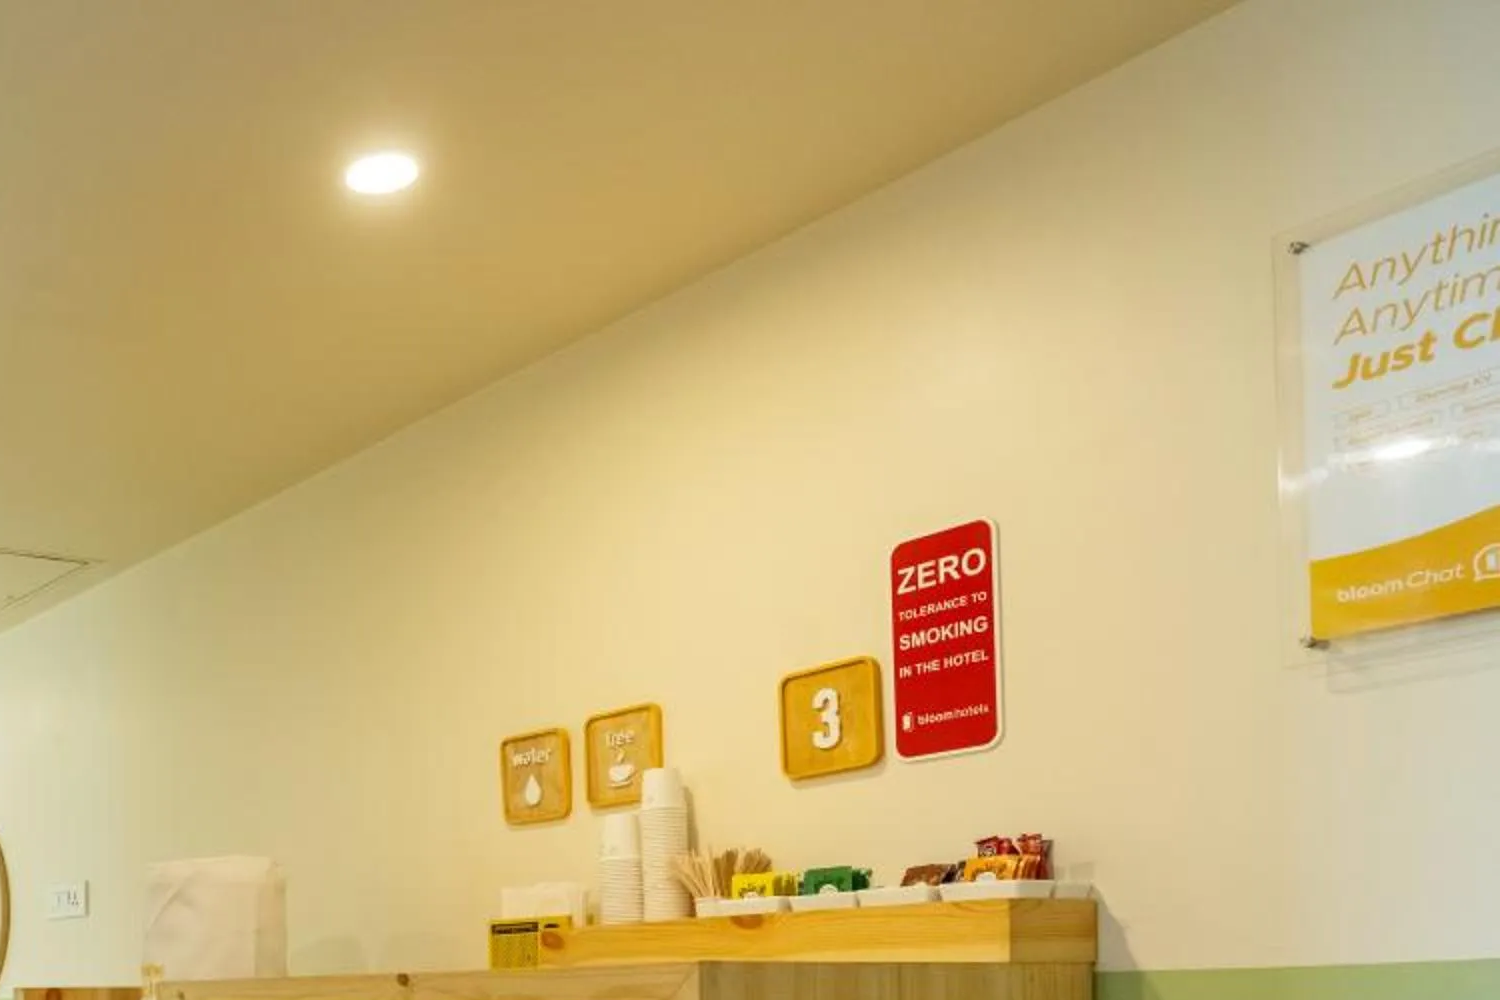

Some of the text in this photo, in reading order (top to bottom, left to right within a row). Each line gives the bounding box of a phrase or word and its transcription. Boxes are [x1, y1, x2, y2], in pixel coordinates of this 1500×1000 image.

[1332, 329, 1438, 390] Just
[897, 547, 987, 595] ZERO
[899, 591, 988, 621] TOLERANCE TO
[899, 615, 989, 650] SMOKING
[899, 649, 989, 678] IN THE HOTEL
[811, 687, 841, 749] 3
